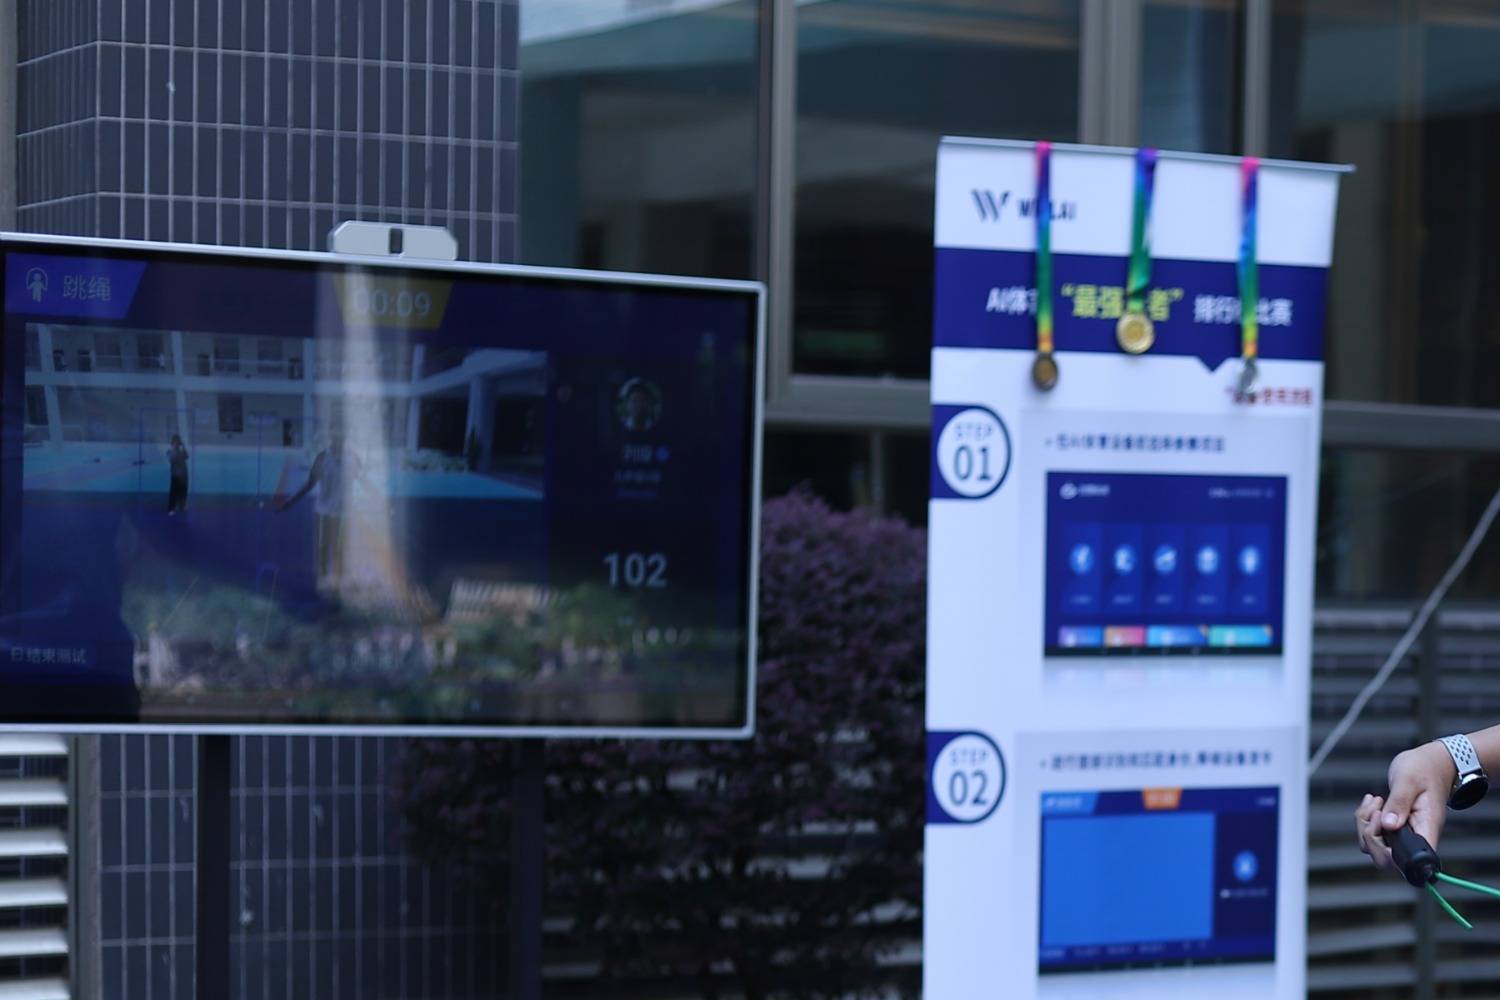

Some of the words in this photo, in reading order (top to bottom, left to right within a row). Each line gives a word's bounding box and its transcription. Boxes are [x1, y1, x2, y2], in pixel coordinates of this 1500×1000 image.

[63, 274, 112, 302] 跳绳
[1061, 283, 1184, 322] “最强者”
[953, 445, 991, 482] 01
[604, 552, 668, 588] 102
[949, 770, 989, 807] 02
